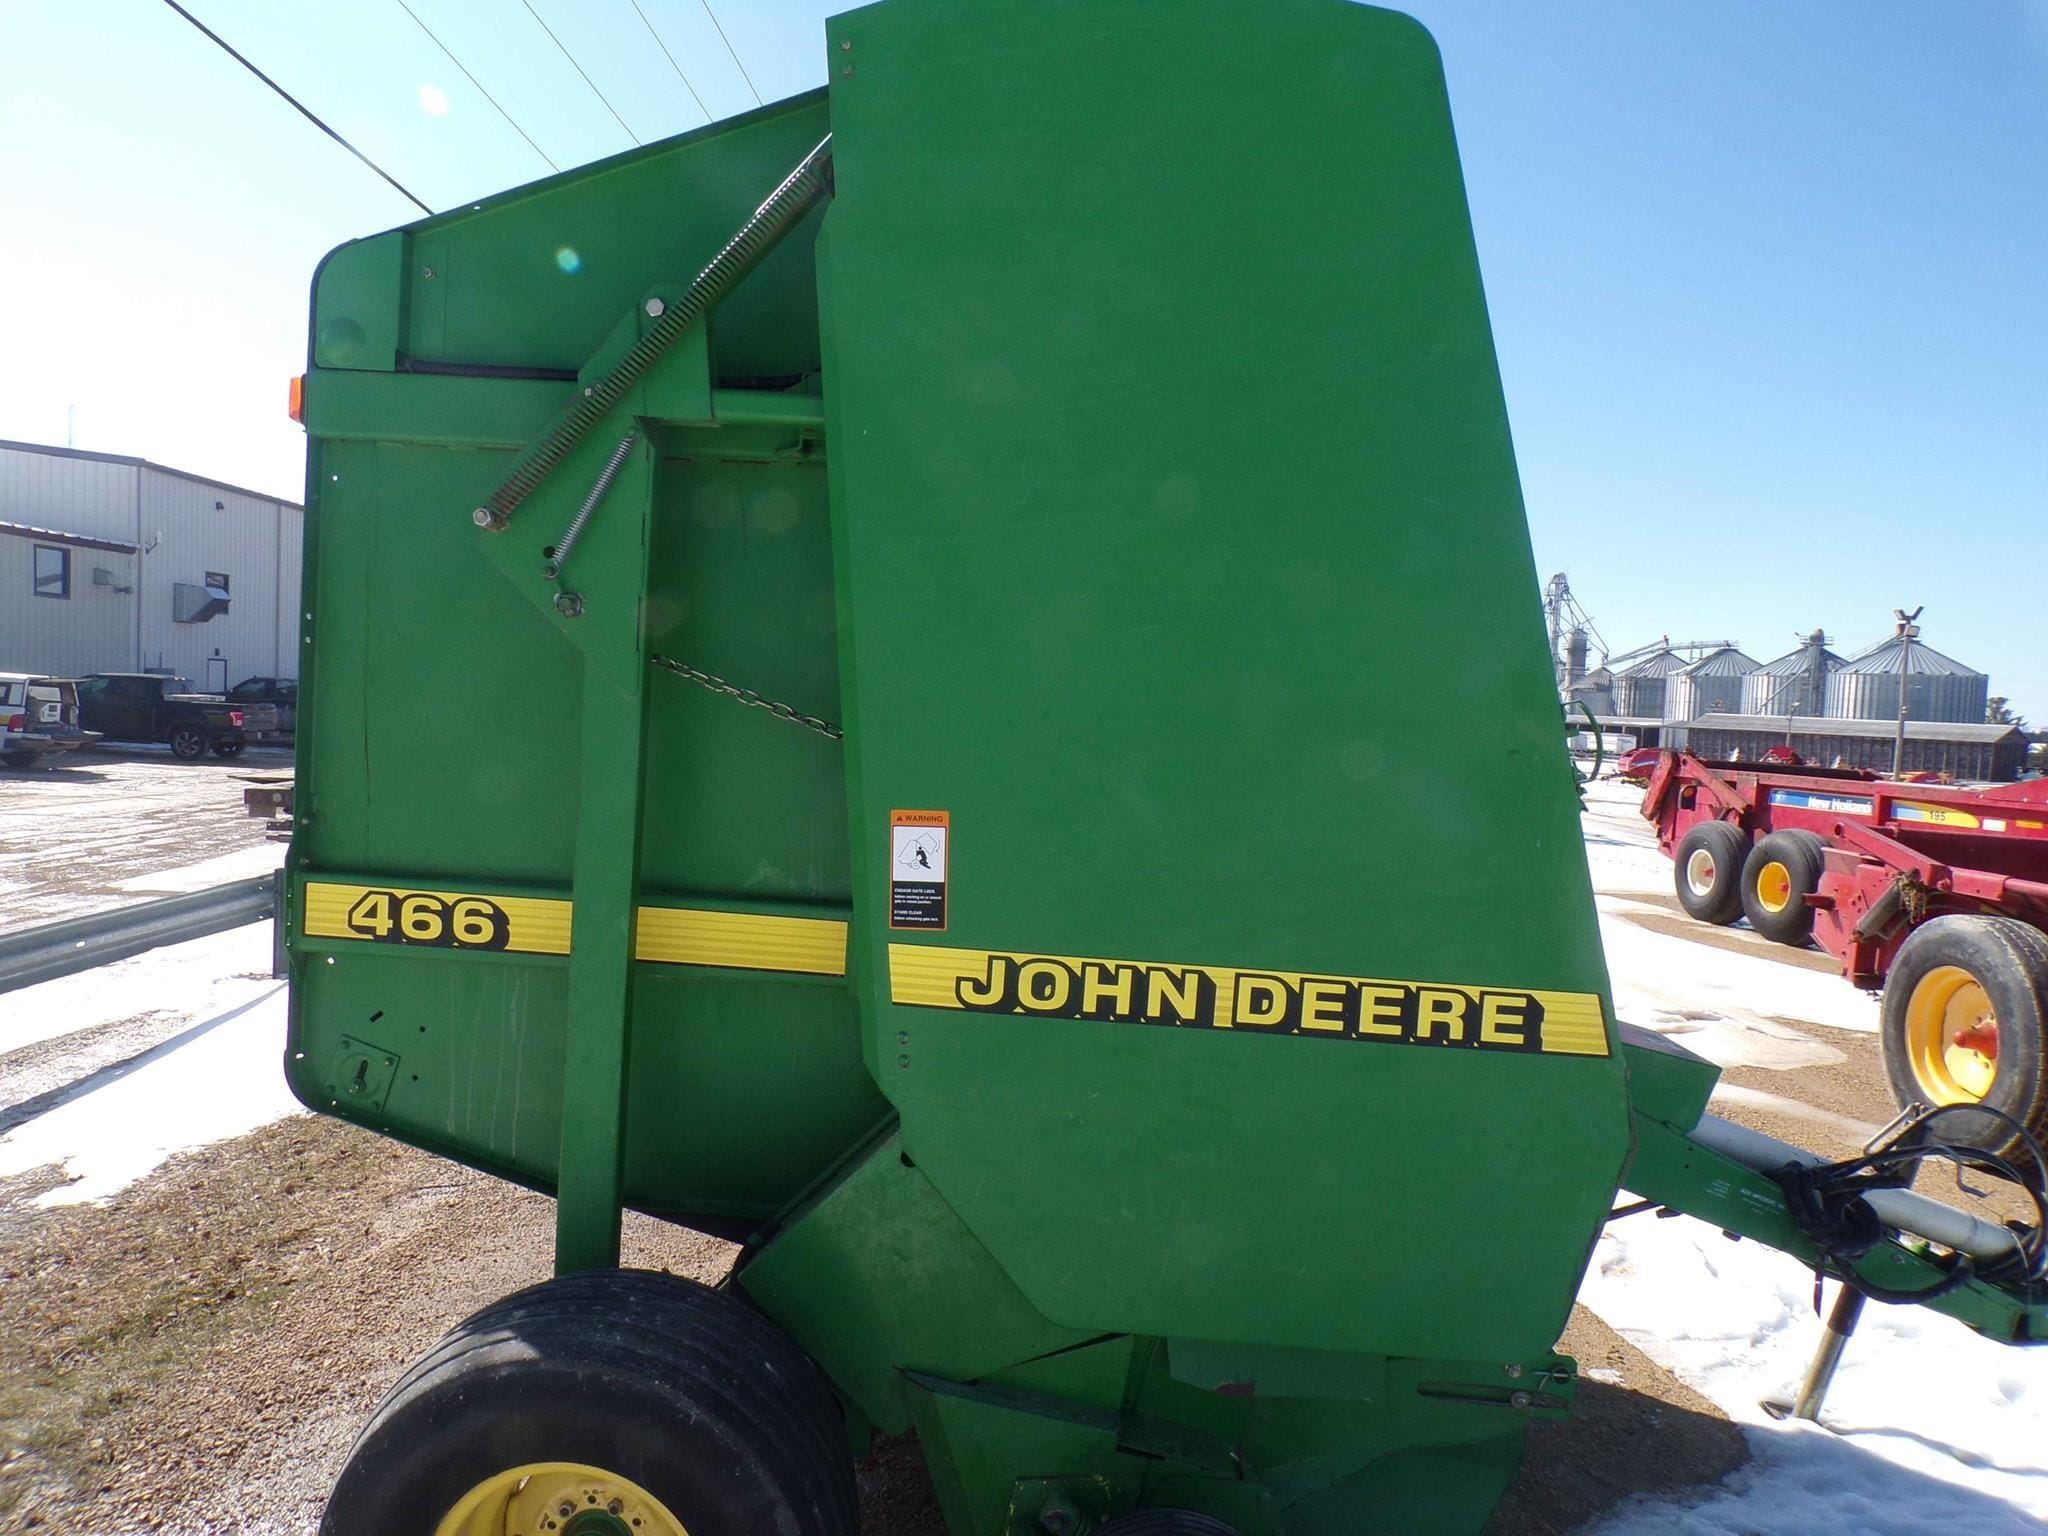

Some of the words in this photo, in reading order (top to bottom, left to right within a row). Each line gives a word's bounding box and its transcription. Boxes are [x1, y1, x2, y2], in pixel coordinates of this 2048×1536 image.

[1807, 796, 1832, 811] New
[1832, 798, 1873, 814] Holland
[904, 814, 943, 823] WARNING
[1929, 810, 1946, 821] 195
[349, 892, 501, 946] 466
[956, 956, 1204, 1024] JOHN
[1233, 972, 1534, 1048] DEERE
